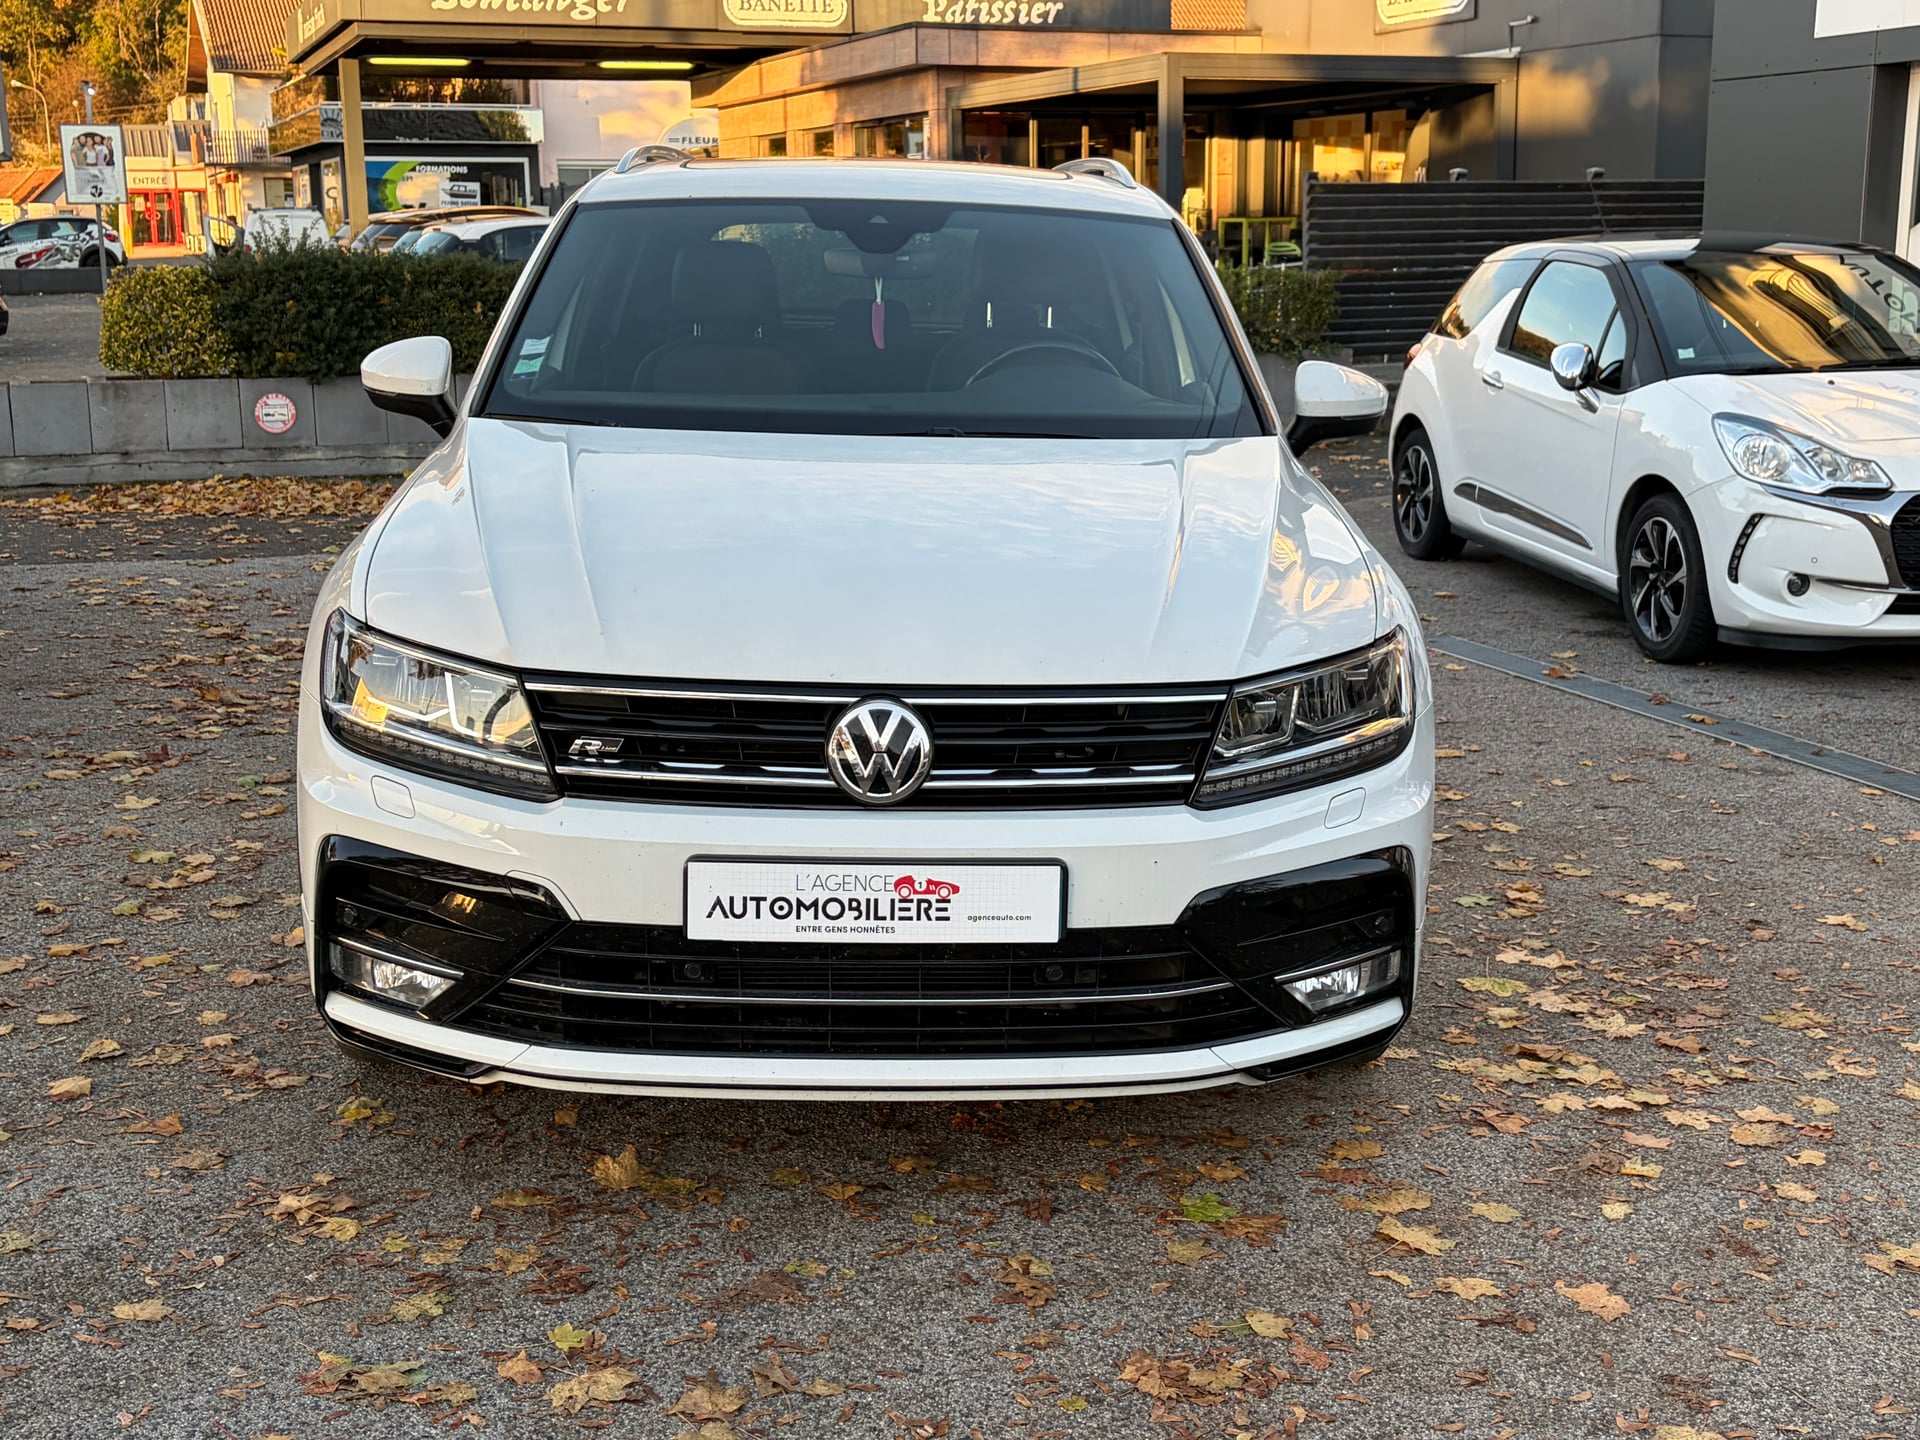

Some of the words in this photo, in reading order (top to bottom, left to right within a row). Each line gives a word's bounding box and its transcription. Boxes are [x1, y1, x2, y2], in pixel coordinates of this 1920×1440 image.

[415, 165, 468, 174] FORMATIONS
[795, 873, 895, 893] L'AGENCE
[967, 913, 1032, 923] agenceauto.com
[795, 925, 823, 934] ENTRE
[824, 925, 848, 934] GENS
[850, 924, 896, 934] HONNÊTES
